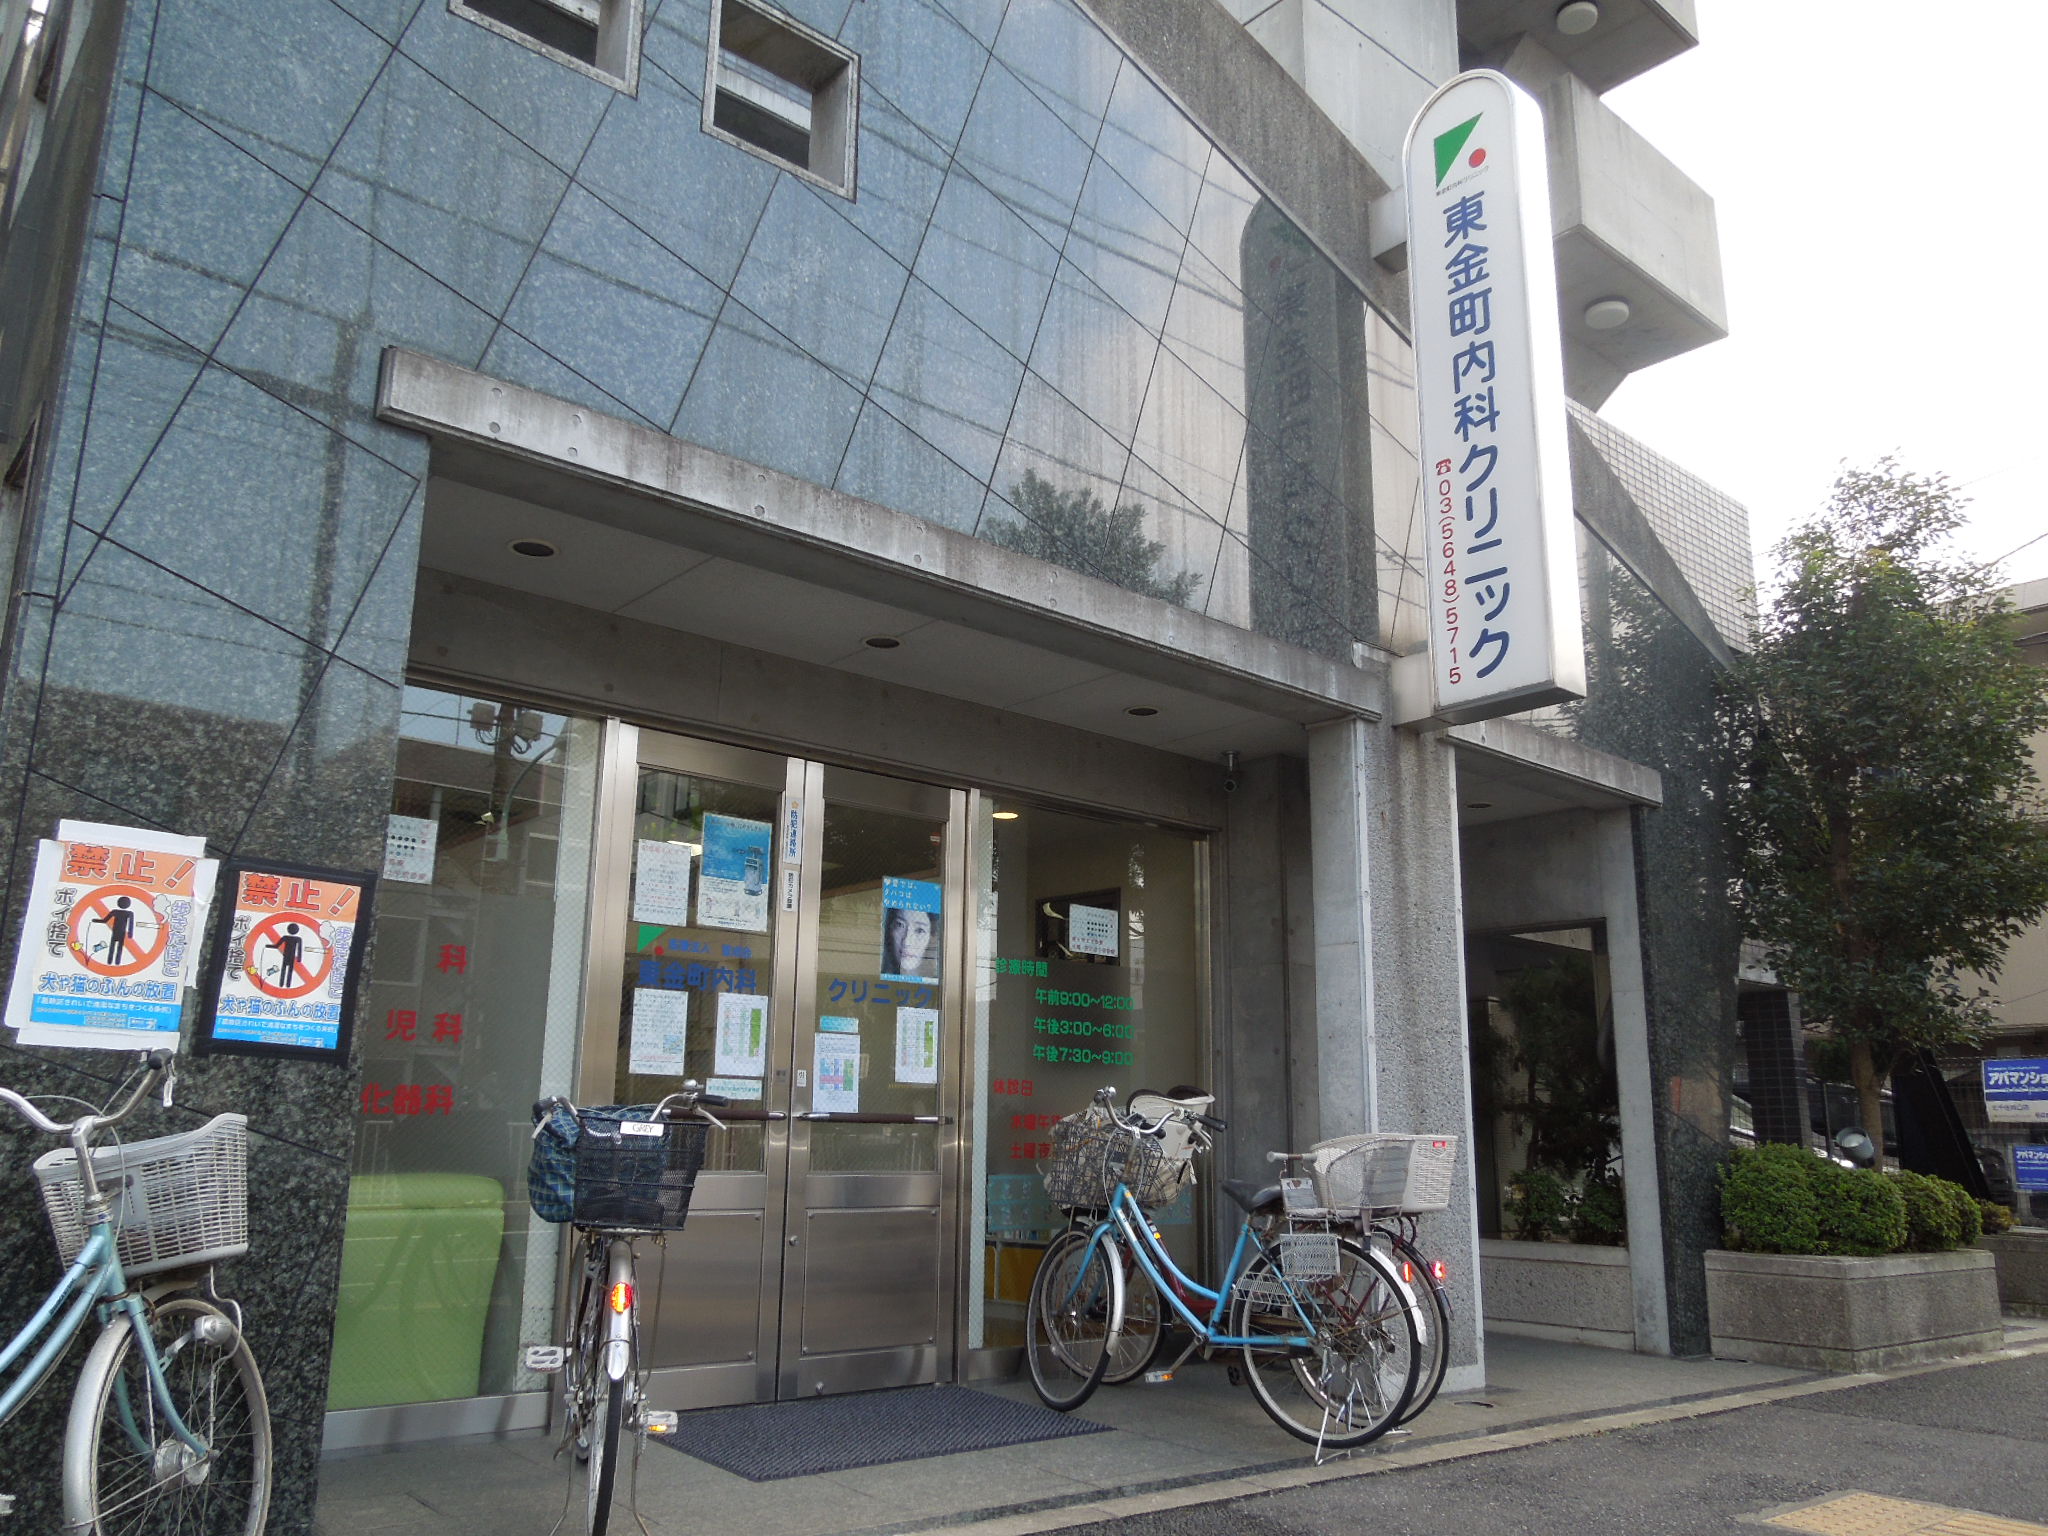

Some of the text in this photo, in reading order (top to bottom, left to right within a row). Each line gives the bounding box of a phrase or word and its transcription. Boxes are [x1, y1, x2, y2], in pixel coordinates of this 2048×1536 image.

[1443, 190, 1510, 679] 東金町内科クリニック
[1438, 479, 1461, 684] 03(5648)5715
[46, 888, 77, 958] ポイ捨て
[162, 901, 192, 978] 歩きたばこ
[225, 916, 251, 982] ポイ捨て
[329, 926, 352, 999] 歩きたばこ
[436, 944, 467, 975] 科
[995, 957, 1048, 979] 診療時間
[39, 972, 178, 1001] 犬や猫のふんの放置
[638, 959, 933, 1008] 東金町内科 クリニック
[219, 996, 341, 1022] 犬や猫のふんの放置
[360, 1082, 455, 1116] 化器科
[993, 1078, 1034, 1098] 休診日
